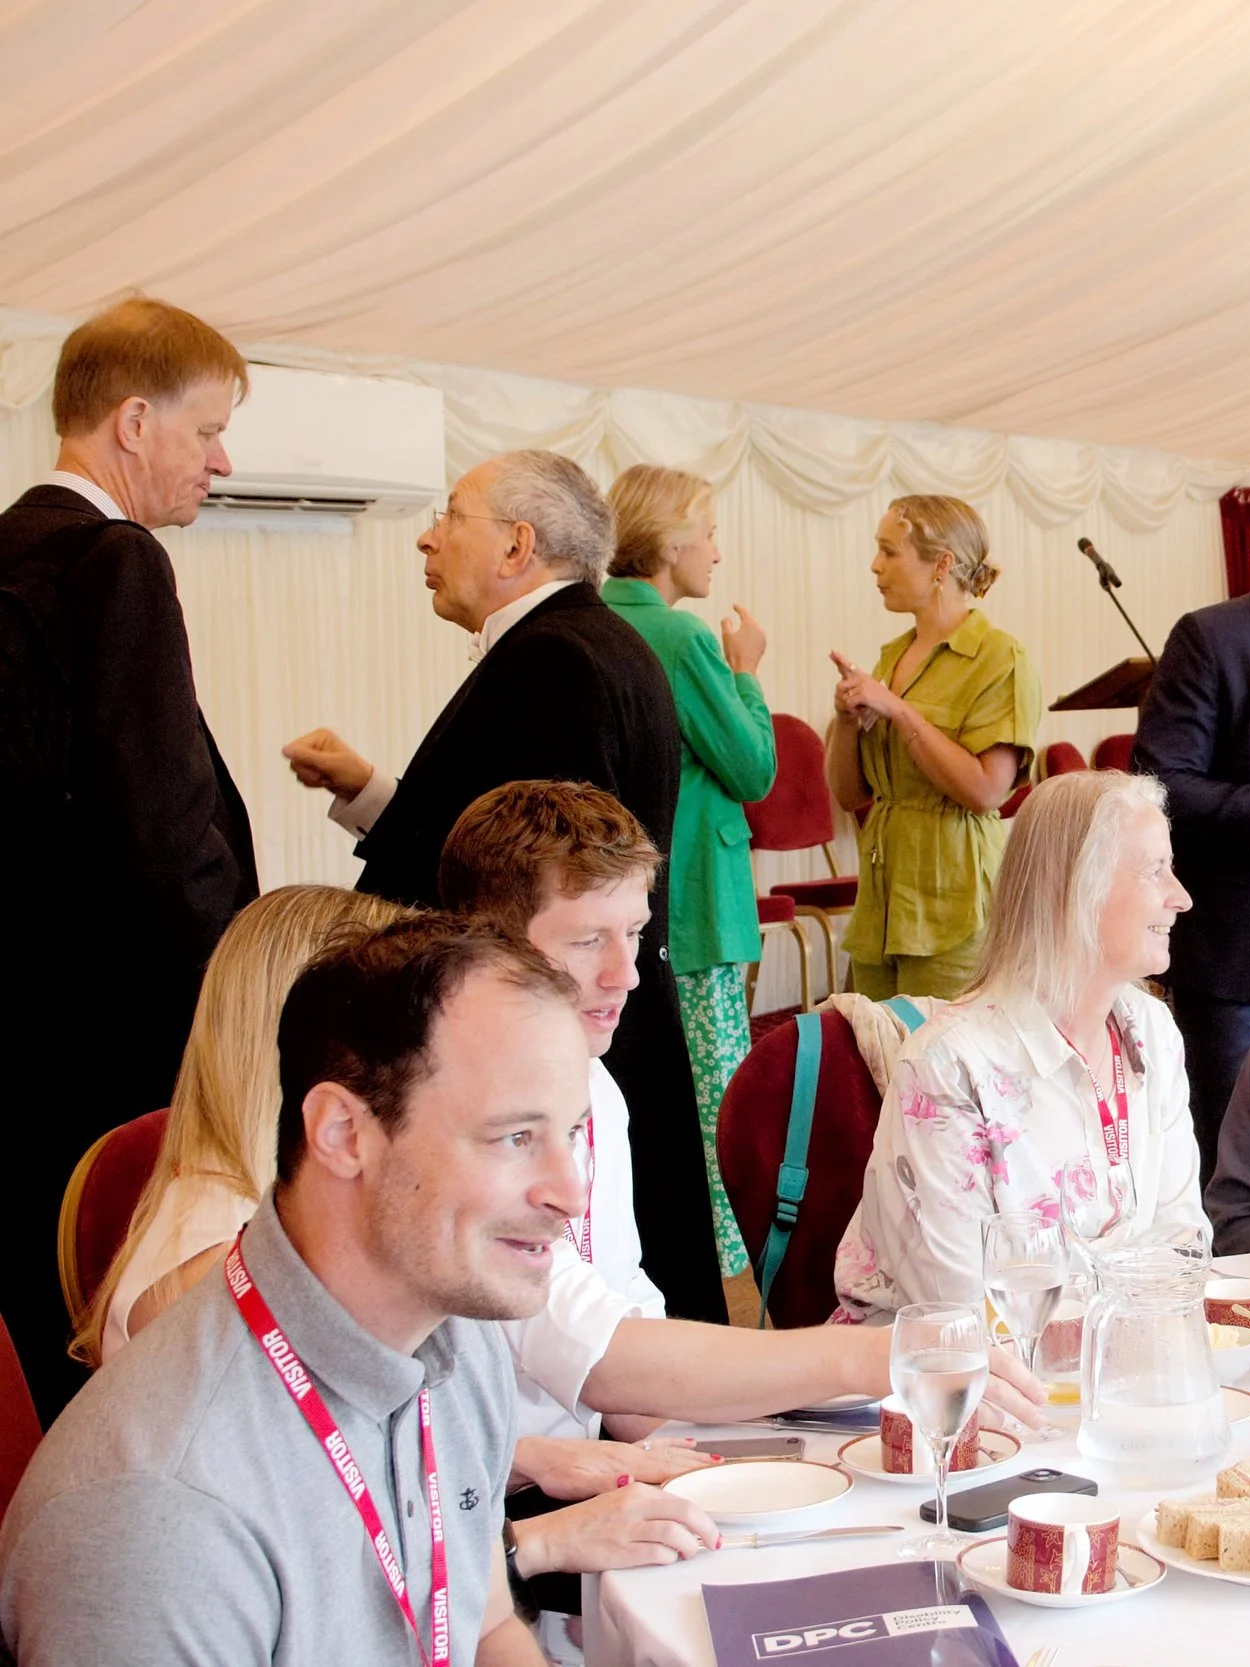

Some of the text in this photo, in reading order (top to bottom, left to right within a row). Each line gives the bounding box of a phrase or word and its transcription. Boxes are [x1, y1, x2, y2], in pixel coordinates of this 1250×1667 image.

[1114, 1055, 1125, 1094] VISITOR
[262, 1327, 313, 1401] VISITOR
[324, 1429, 367, 1501] VISITOR
[428, 1471, 445, 1543] VISITOR
[374, 1529, 406, 1599] VISITOR
[433, 1586, 449, 1661] VISITOR
[763, 1620, 878, 1653] DPC
[893, 1609, 961, 1622] Disability
